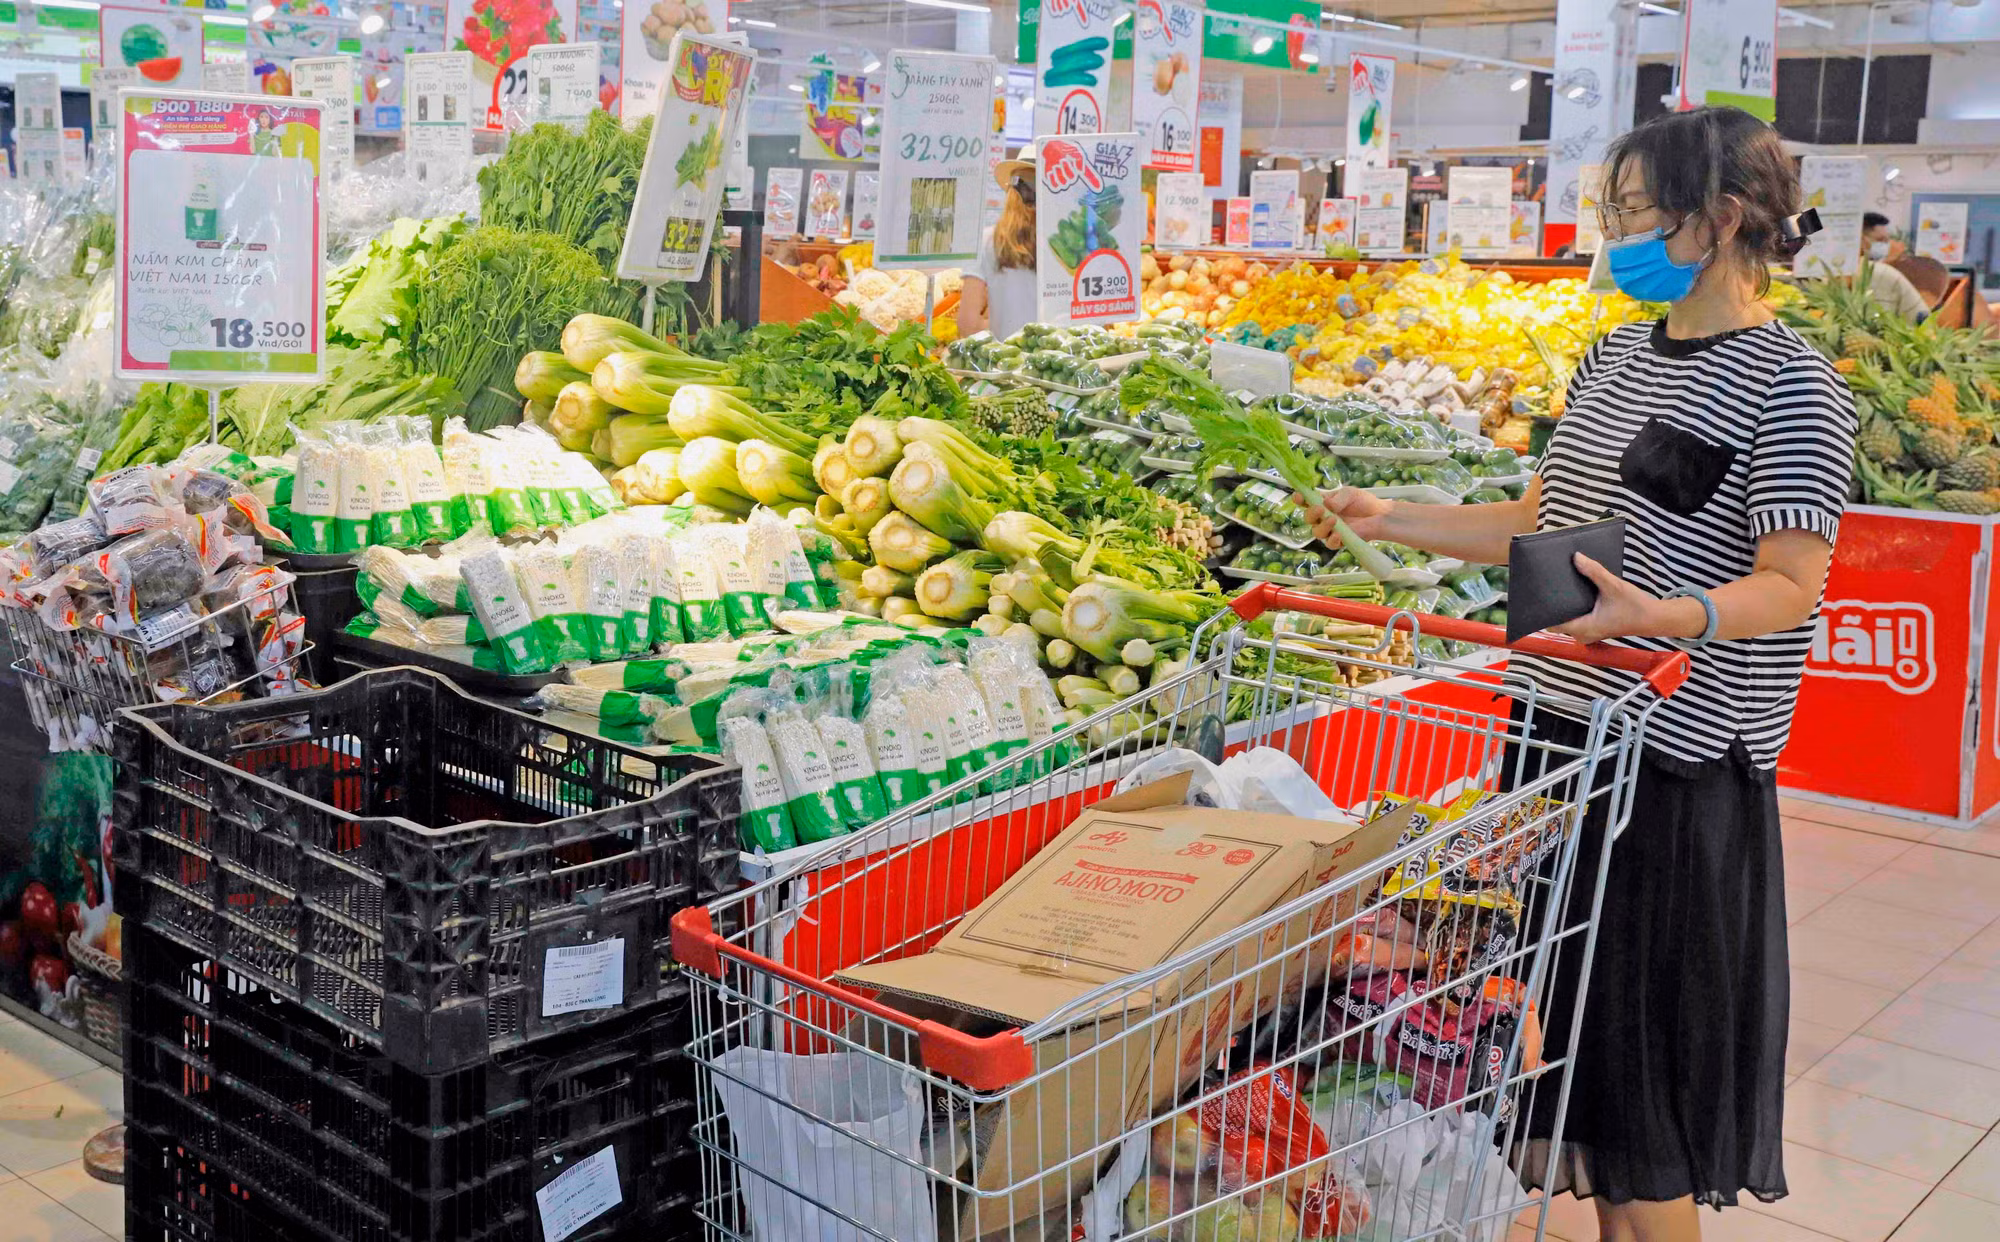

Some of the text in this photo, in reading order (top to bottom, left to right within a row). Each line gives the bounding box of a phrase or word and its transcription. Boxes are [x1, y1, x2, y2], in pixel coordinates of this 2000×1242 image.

[960, 77, 983, 88] XANH
[929, 93, 960, 104] 250GR
[194, 101, 234, 113] 1880
[901, 132, 983, 163] 32.900
[175, 255, 205, 267] KIM
[130, 269, 163, 283] VIỆT
[169, 272, 206, 285] NAM
[539, 593, 565, 602] KINOKO
[490, 605, 515, 620] KINOKO
[998, 715, 1021, 723] KINOKO
[878, 744, 902, 753] KINOKO
[920, 746, 939, 755] KINOKO
[832, 753, 855, 763] KINOKO
[803, 764, 827, 774] KINOKO
[755, 778, 778, 788] KINOKO
